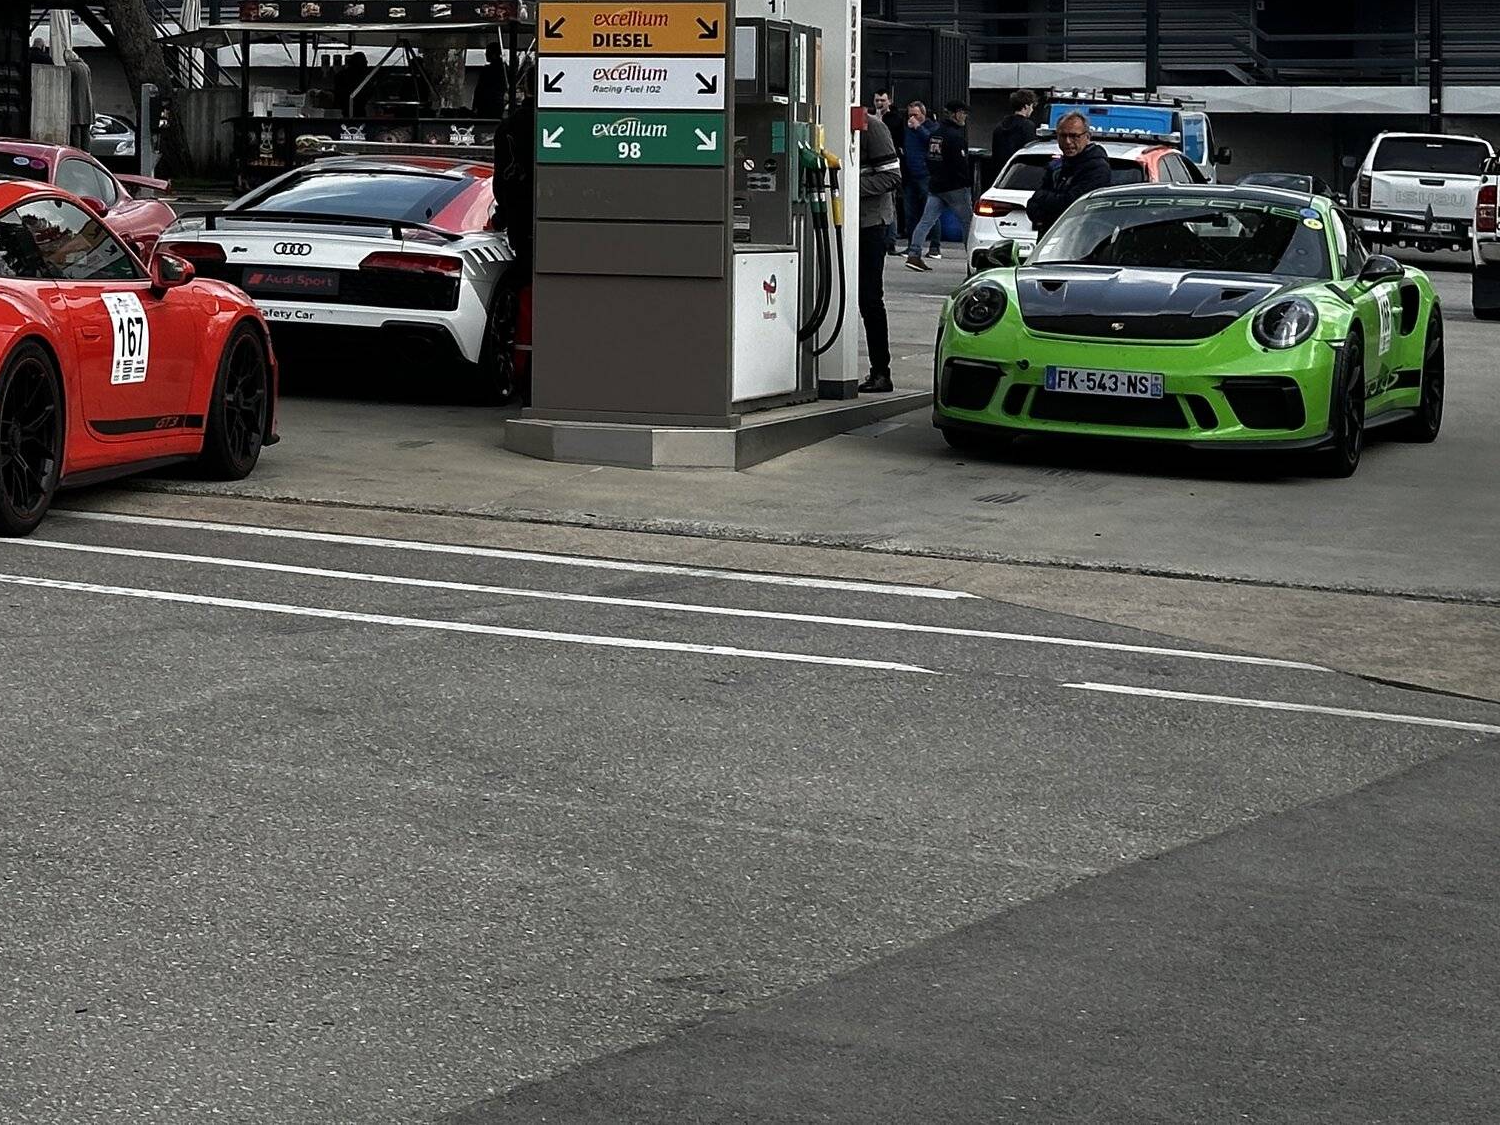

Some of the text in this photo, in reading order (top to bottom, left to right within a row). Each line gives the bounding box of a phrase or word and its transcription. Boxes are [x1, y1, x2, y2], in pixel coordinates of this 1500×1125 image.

[768, 0, 776, 14] 1
[593, 10, 669, 27] excellium
[592, 33, 653, 48] DIESEL
[592, 64, 668, 82] excellium
[592, 85, 661, 94] Racing Fuel 102
[591, 120, 668, 138] excellium
[617, 141, 642, 159] 98
[1084, 198, 1302, 222] PORSCHE
[264, 273, 333, 287] Audi Sport
[294, 310, 315, 320] Car
[118, 316, 144, 358] 167
[1057, 369, 1149, 395] FK-543-NS
[155, 416, 180, 429] GT3
